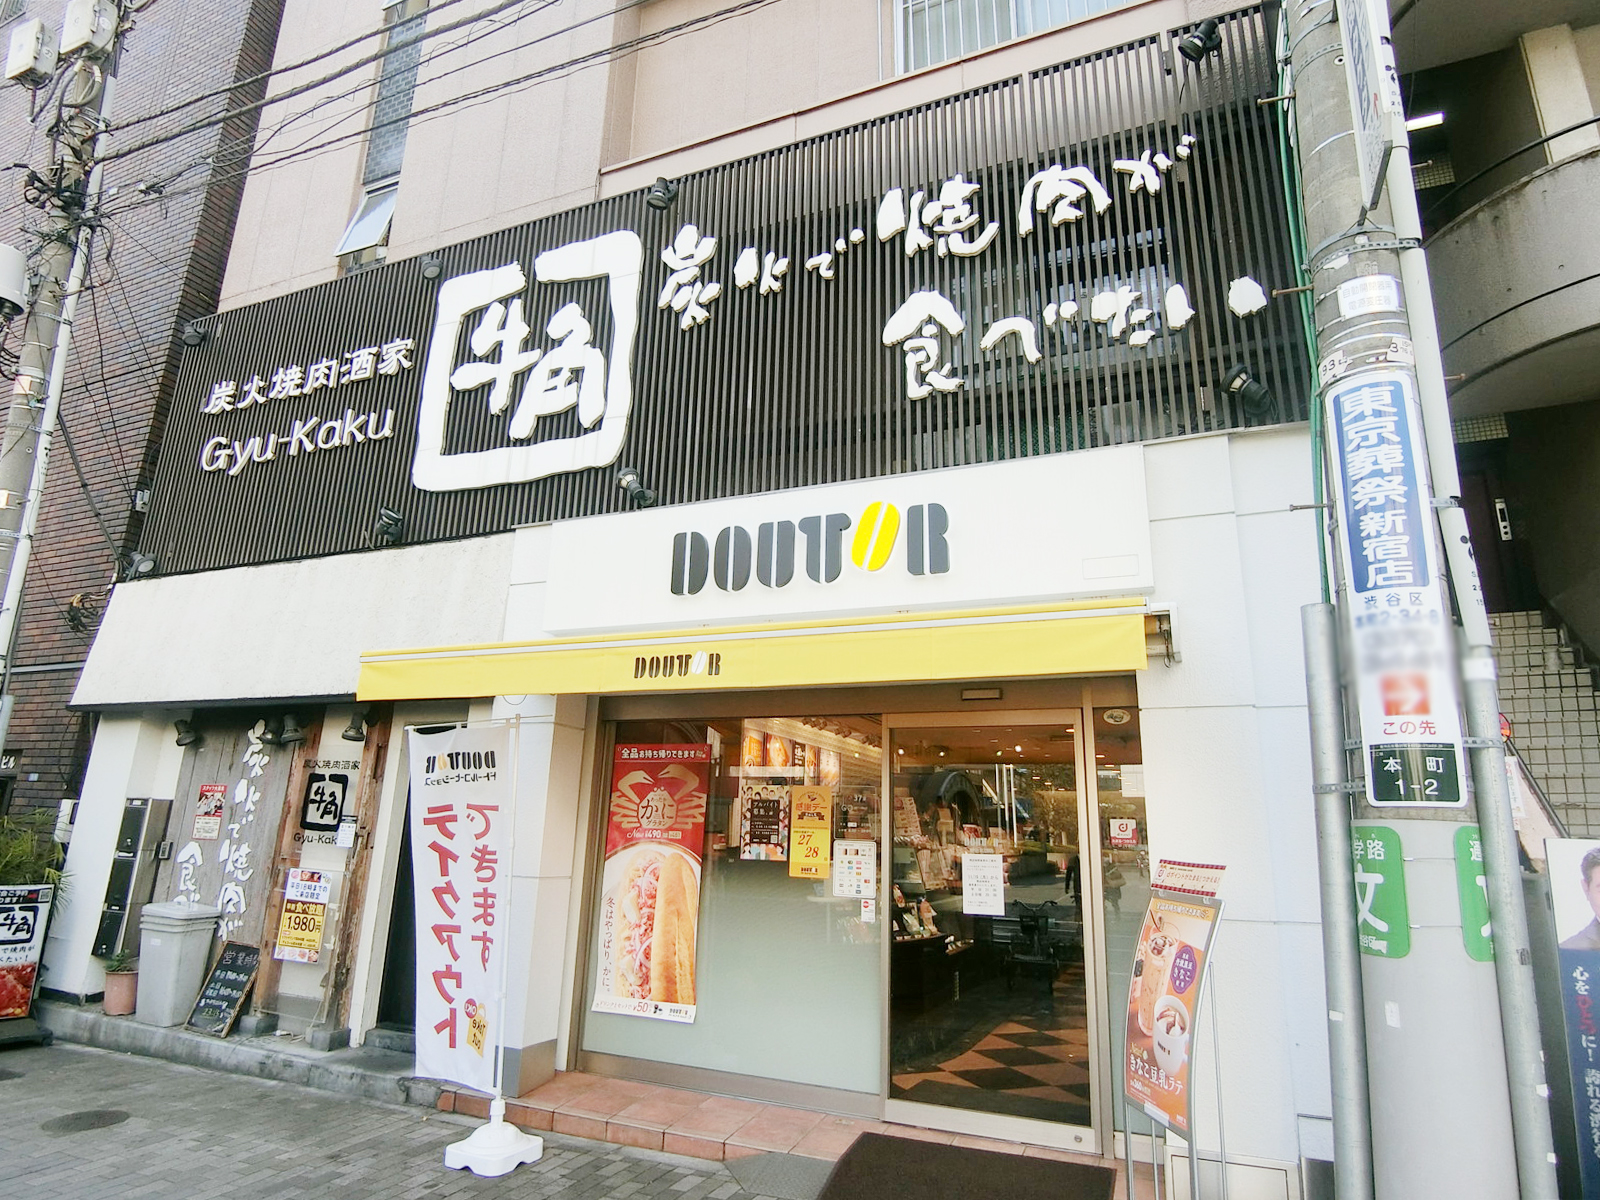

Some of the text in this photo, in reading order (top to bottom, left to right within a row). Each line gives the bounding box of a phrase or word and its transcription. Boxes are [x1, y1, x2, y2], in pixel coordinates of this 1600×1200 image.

[658, 133, 1196, 331] 炭火で焼肉が
[202, 336, 415, 416] 炭火焼肉酒家
[450, 301, 608, 442] 牛角
[199, 405, 396, 477] Gyu-Kaku
[1339, 385, 1415, 589] 東京葬祭新宿店
[670, 500, 951, 597] DOUTOR
[1364, 592, 1424, 610] 渋谷区
[633, 650, 722, 679] DOUTOR
[1383, 720, 1437, 736] この先
[303, 760, 360, 770] 炭火焼肉酒家
[1382, 756, 1444, 773] 本町
[1394, 778, 1439, 795] 1-2
[309, 785, 339, 821] 牛角
[640, 798, 675, 820] かに
[293, 833, 338, 845] Gyu-Kak
[797, 834, 813, 846] 27
[804, 846, 820, 859] 28
[1130, 1053, 1183, 1096] きなこ豆乳ラテ
